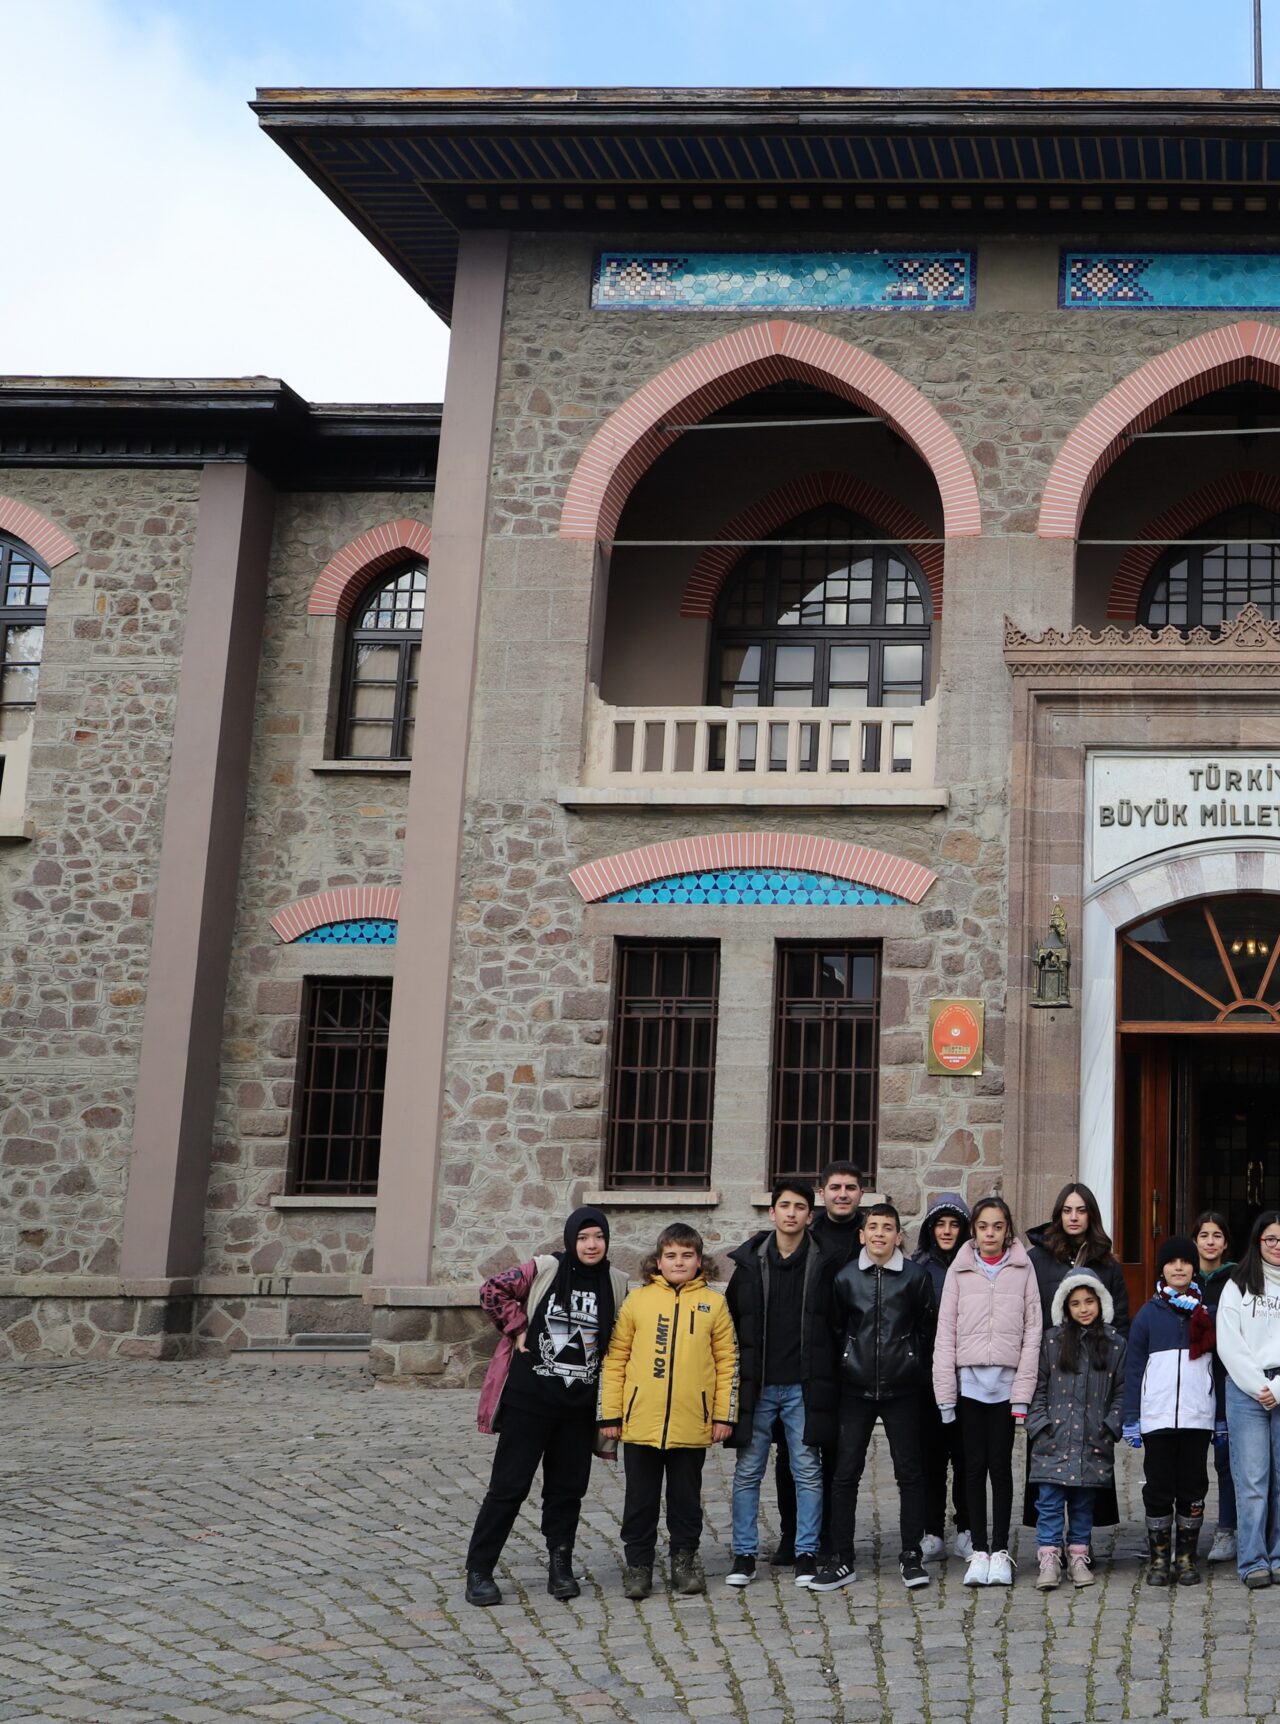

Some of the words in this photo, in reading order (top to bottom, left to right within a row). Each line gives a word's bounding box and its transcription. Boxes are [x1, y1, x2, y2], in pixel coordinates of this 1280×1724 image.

[1099, 799, 1188, 827] BÜYÜK
[655, 1313, 670, 1355] LIMIT
[653, 1357, 666, 1379] NO
